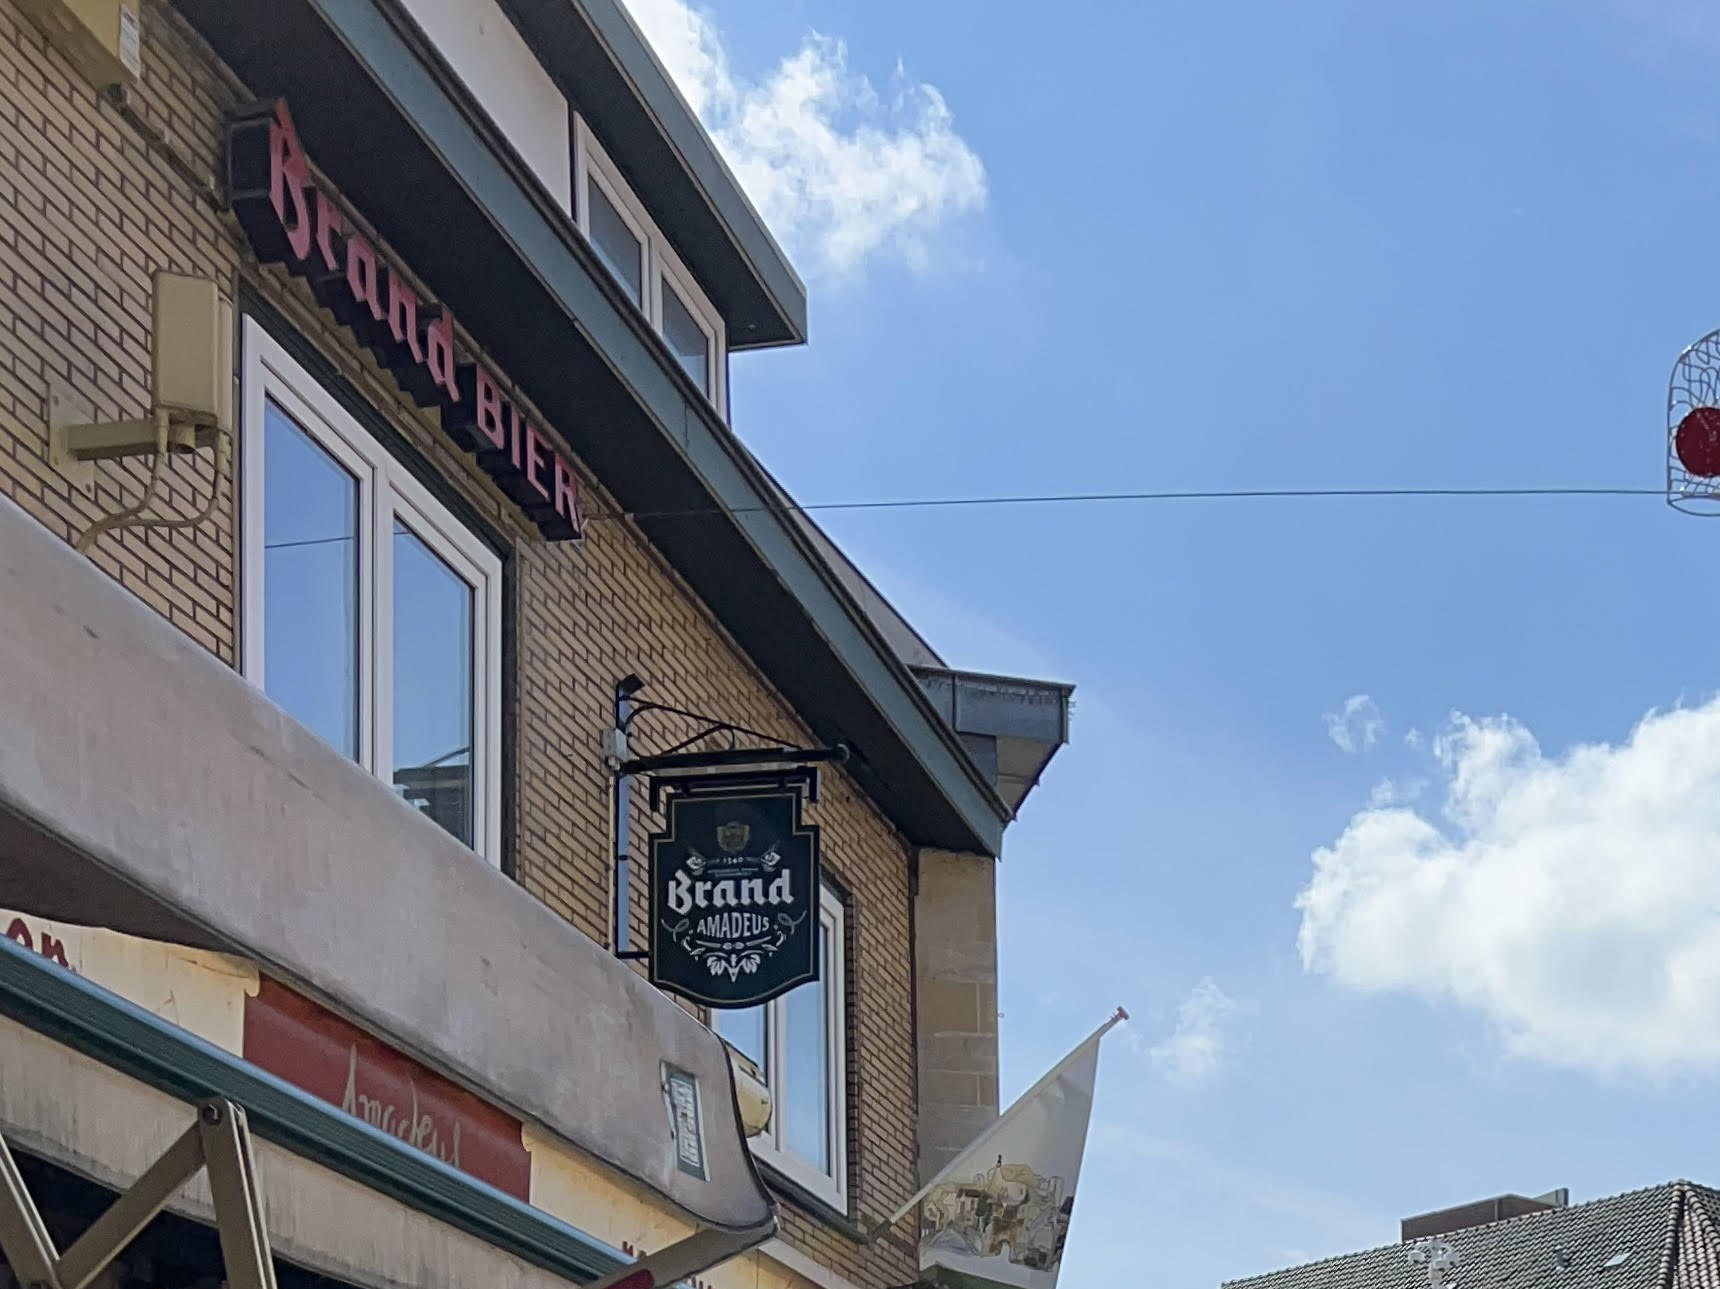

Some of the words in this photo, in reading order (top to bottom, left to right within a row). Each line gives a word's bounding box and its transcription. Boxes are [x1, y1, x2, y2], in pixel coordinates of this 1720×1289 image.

[269, 97, 459, 402] Brand
[476, 362, 582, 533] BIER
[667, 869, 794, 915] Brand
[697, 912, 769, 938] AMADEUS
